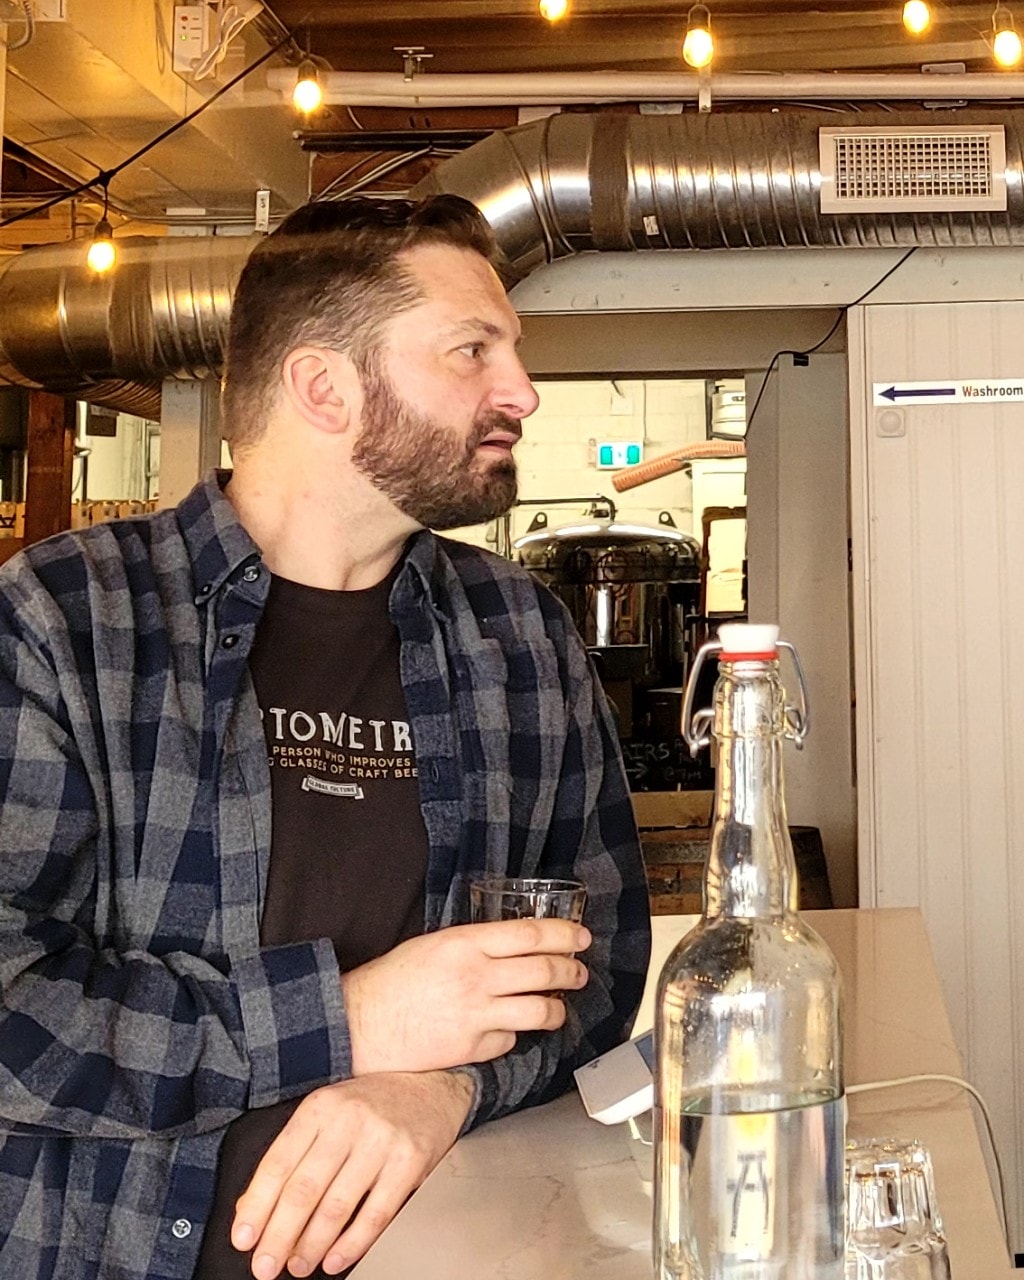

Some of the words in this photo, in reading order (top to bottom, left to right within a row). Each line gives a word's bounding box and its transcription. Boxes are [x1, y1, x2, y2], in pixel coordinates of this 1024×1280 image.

[962, 385, 1024, 397] Washroom
[259, 707, 413, 752] TOMETR
[272, 745, 321, 757] PERSON
[325, 749, 345, 764] WHO
[350, 756, 411, 767] IMPROVES
[280, 757, 327, 771] GLASSES
[330, 763, 344, 775] OF
[349, 767, 388, 779] CRAFT
